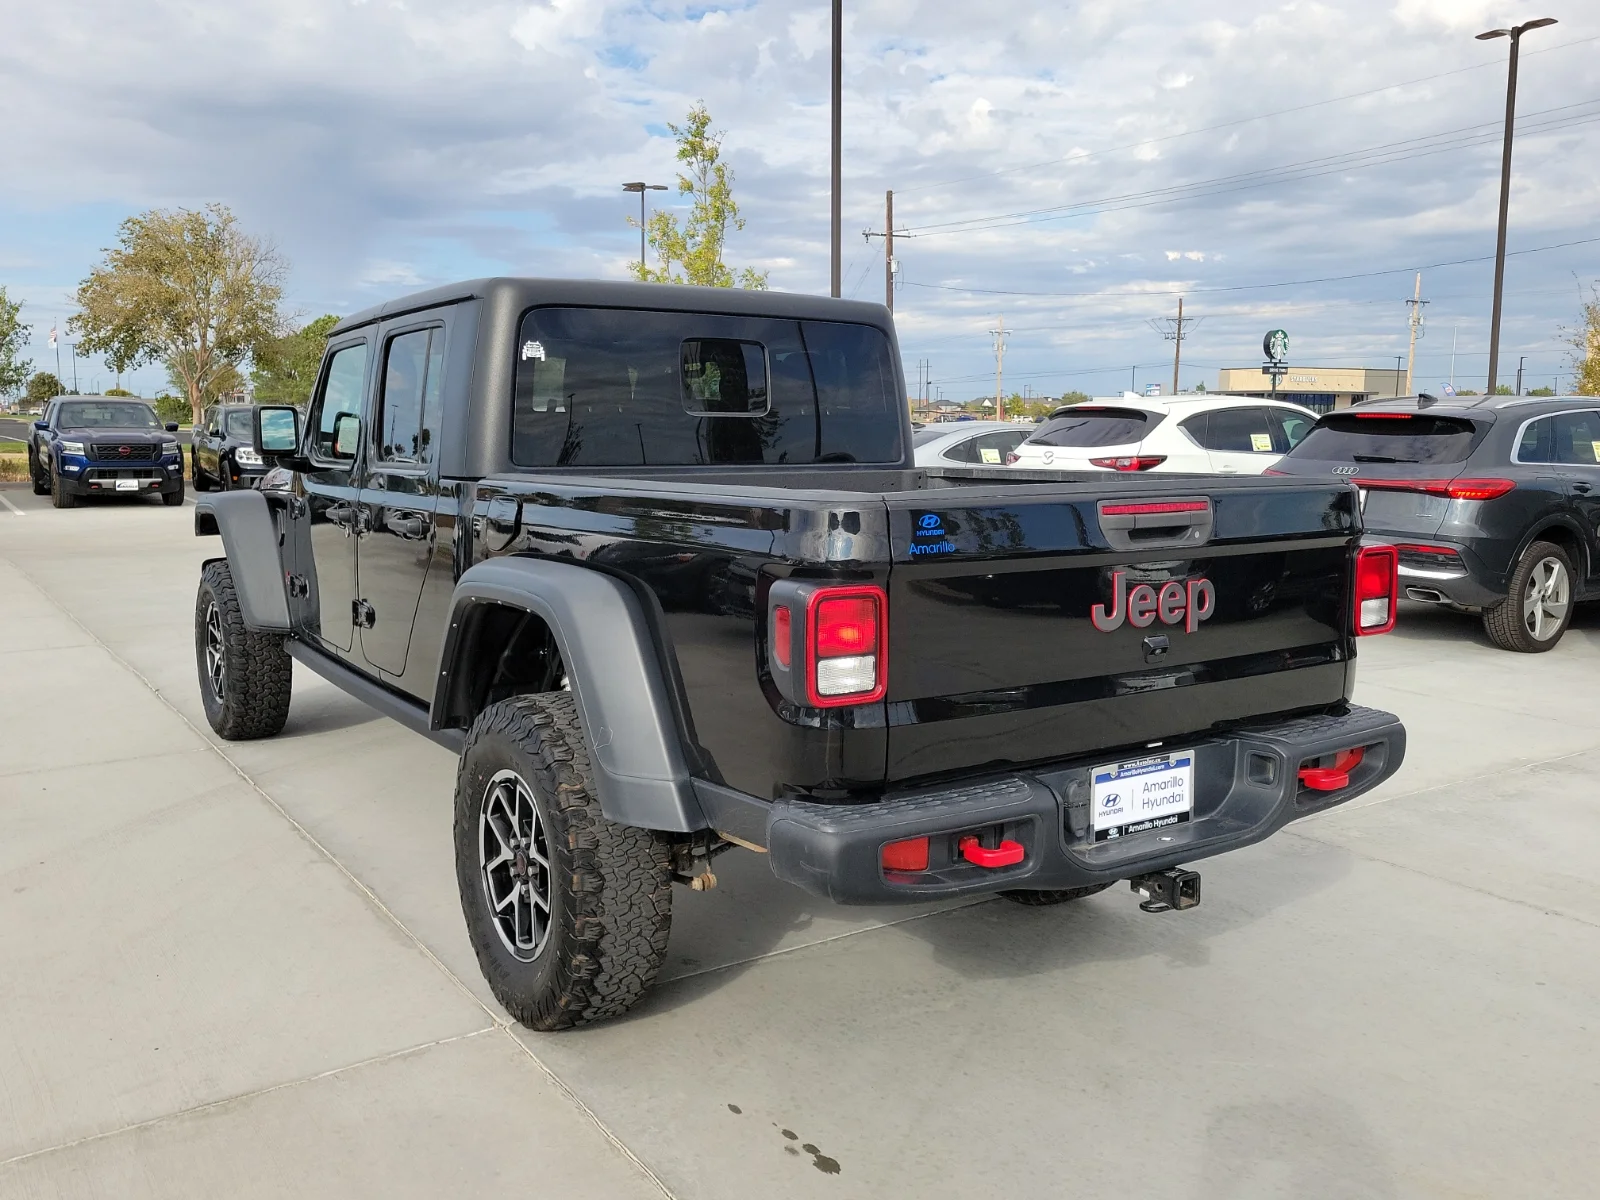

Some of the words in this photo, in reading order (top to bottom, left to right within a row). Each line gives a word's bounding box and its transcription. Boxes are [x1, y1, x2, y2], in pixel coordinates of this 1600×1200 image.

[909, 540, 956, 555] Amarillo
[1091, 571, 1216, 634] Jeep
[1142, 776, 1184, 794] Amarillo
[1142, 790, 1184, 810] Hyundai
[1098, 807, 1123, 817] HYUNDAI
[1128, 821, 1153, 833] Amarillo
[1153, 815, 1178, 828] Hyundai
